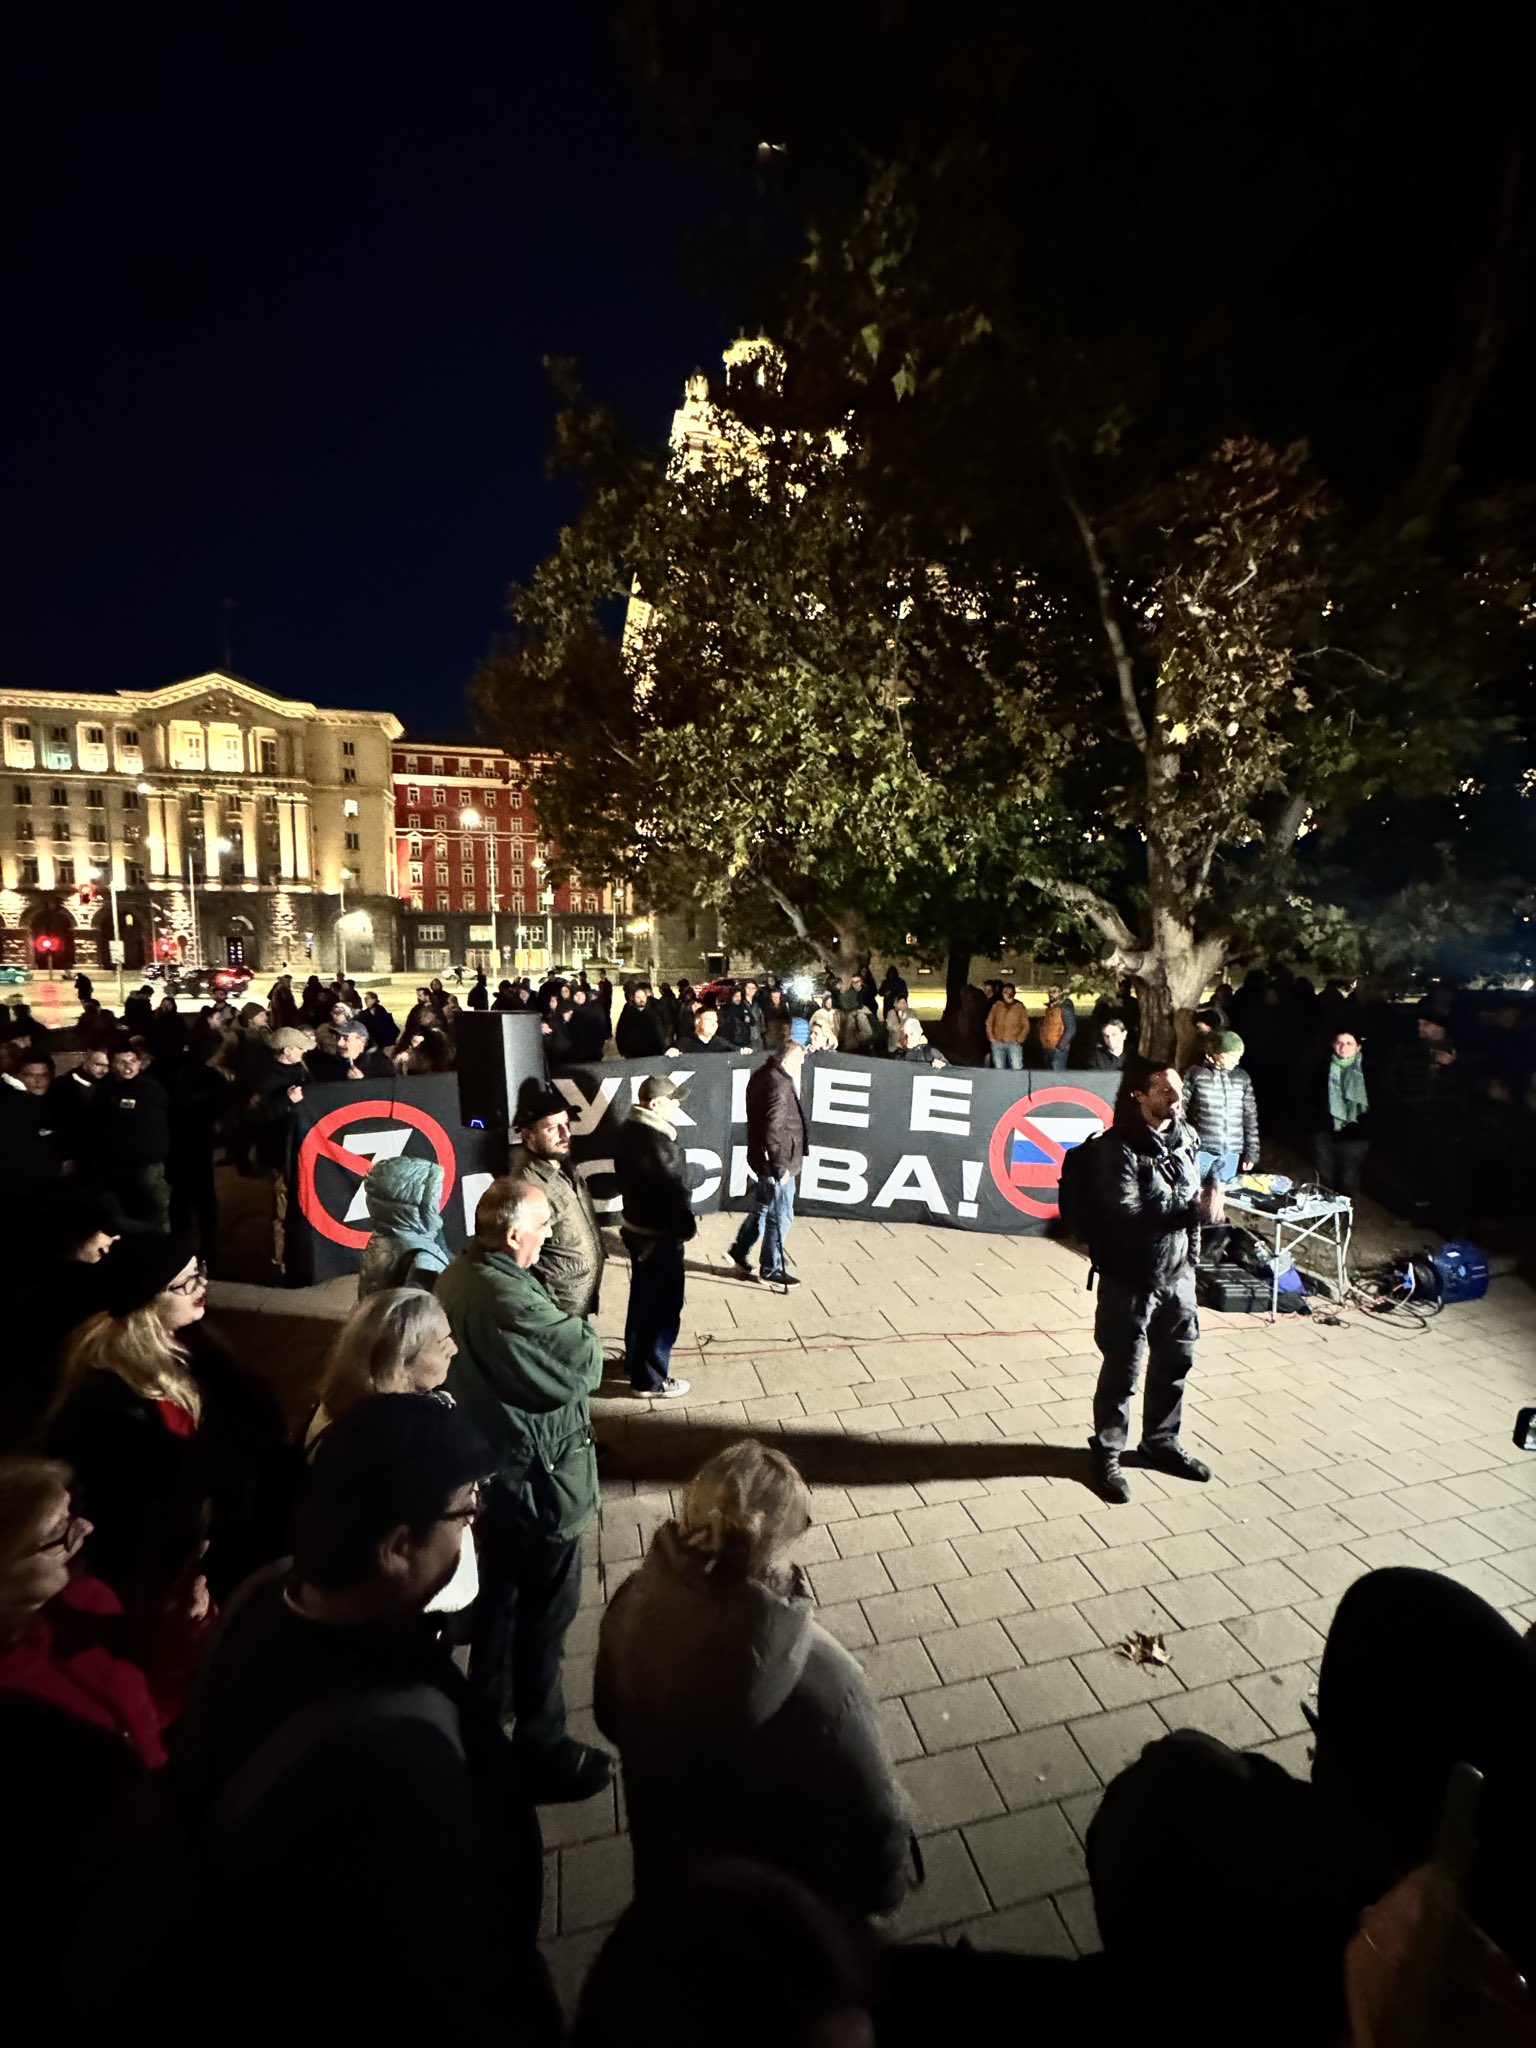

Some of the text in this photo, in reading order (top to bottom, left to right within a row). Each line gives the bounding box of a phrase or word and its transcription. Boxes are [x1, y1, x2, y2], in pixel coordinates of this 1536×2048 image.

[508, 1071, 697, 1145] УК
[909, 1075, 973, 1136] Е
[461, 1145, 984, 1236] СВА!
